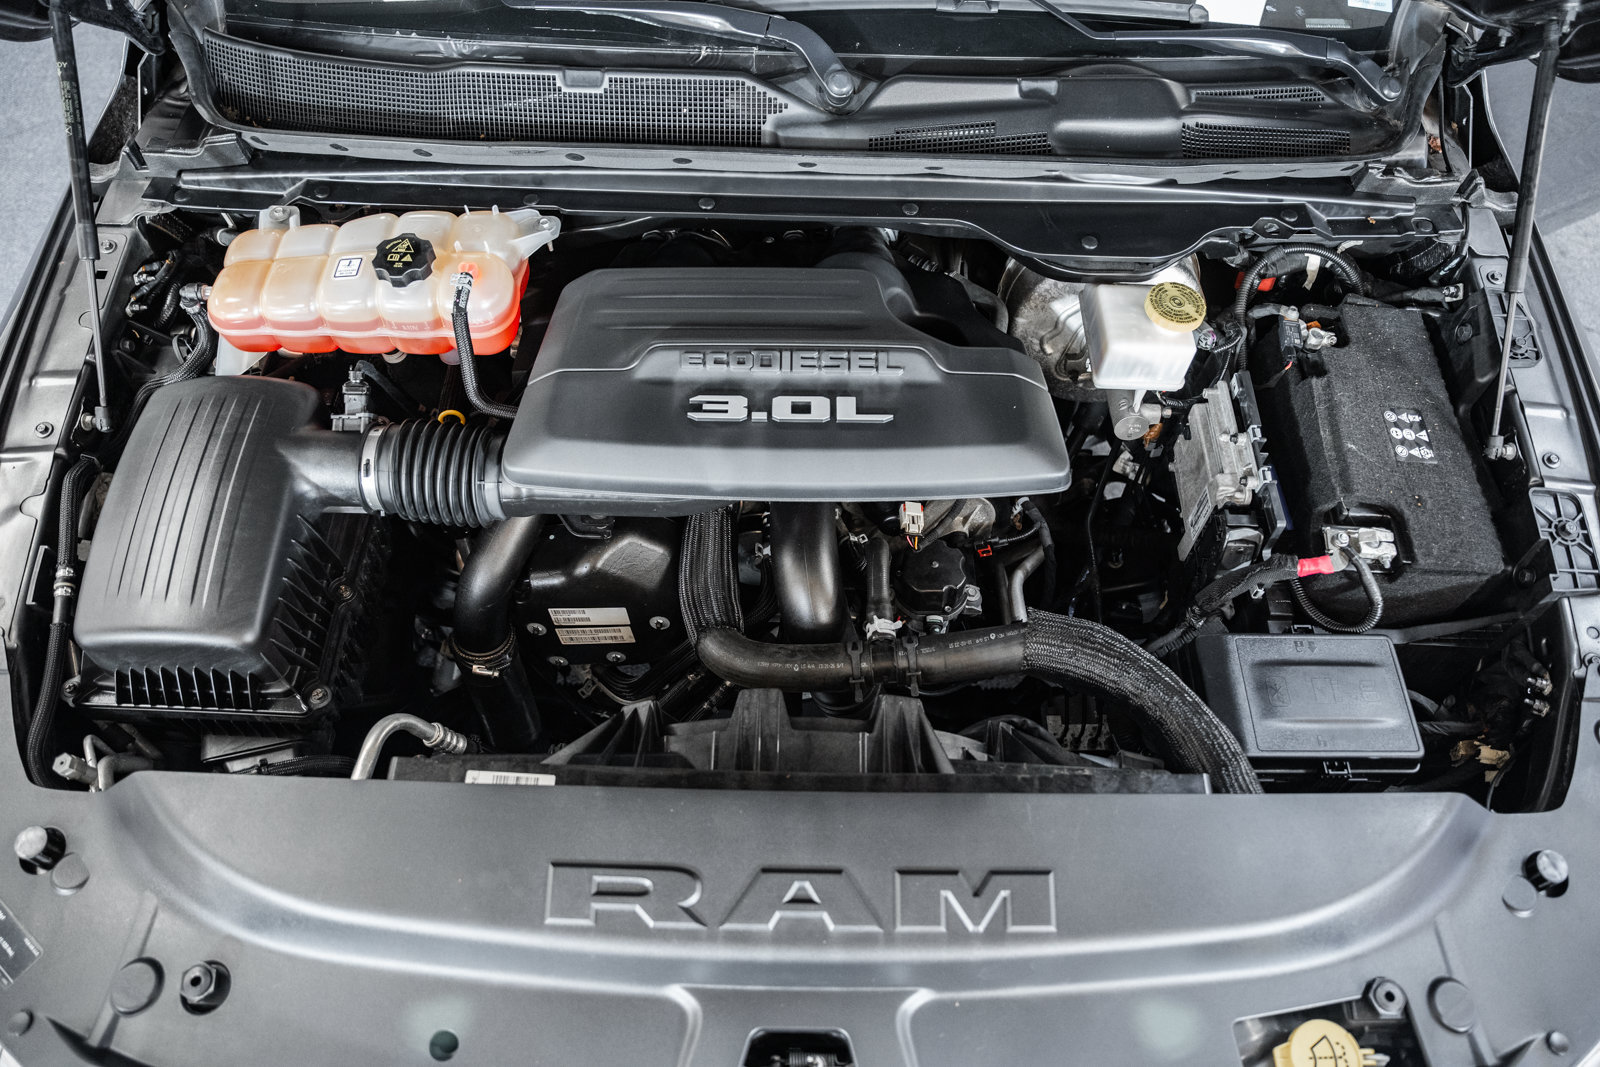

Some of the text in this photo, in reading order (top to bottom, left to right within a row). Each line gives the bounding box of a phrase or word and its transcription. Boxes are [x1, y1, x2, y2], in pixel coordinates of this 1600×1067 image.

[681, 351, 904, 376] ECODIESEL
[687, 395, 894, 423] 3.0L
[545, 861, 1057, 933] RAM
